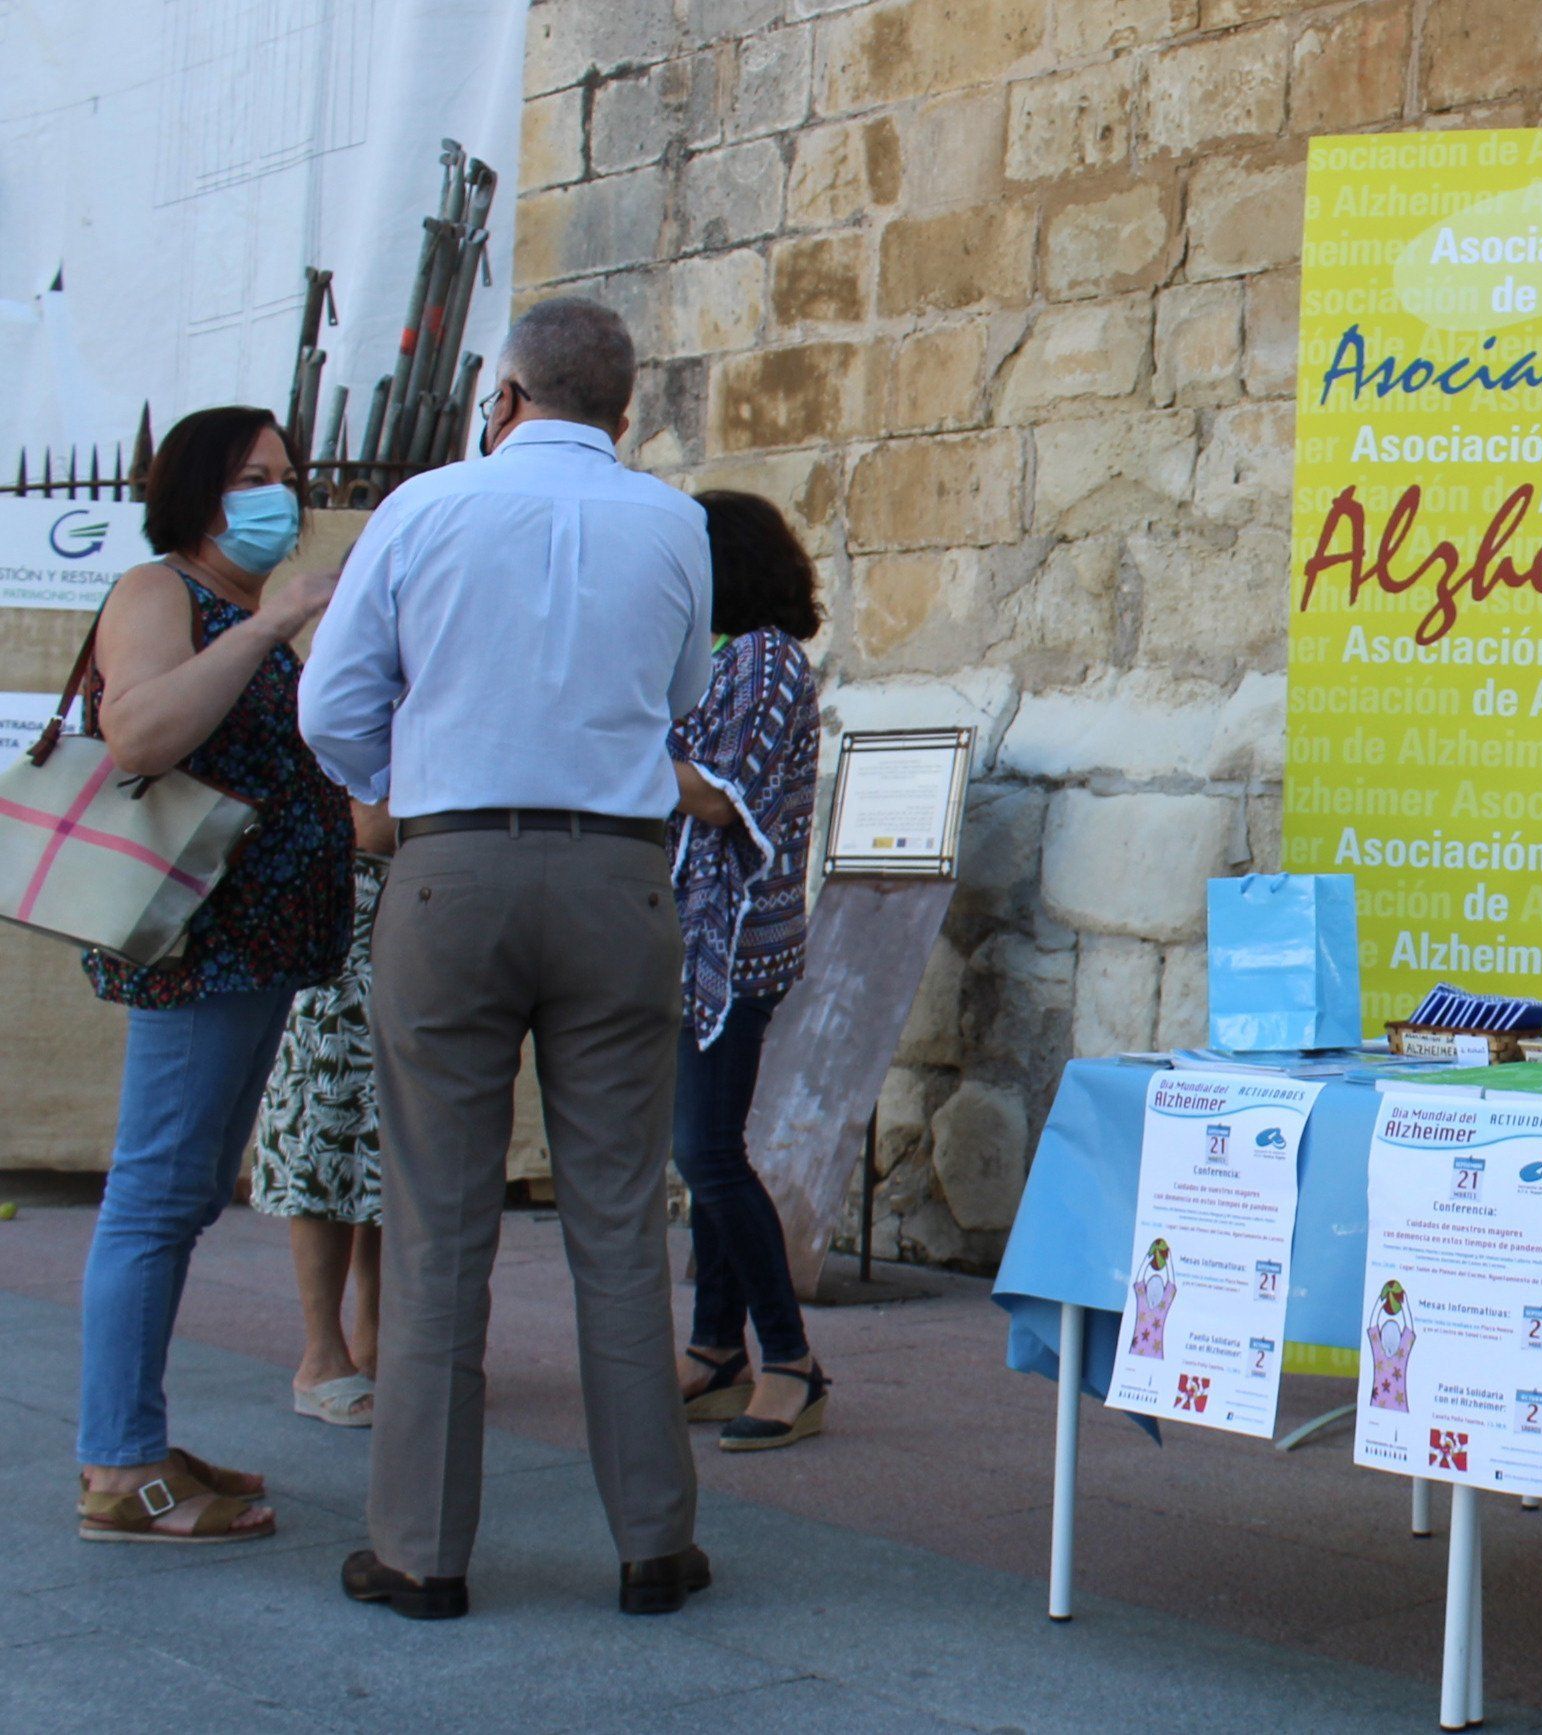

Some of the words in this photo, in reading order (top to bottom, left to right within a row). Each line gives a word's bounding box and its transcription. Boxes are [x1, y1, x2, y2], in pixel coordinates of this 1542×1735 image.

[1478, 131, 1519, 166] de
[1491, 276, 1536, 313] de
[1471, 678, 1519, 717] de
[1341, 726, 1387, 766] de
[1463, 883, 1509, 921] de
[1154, 1090, 1226, 1112] Alzheimer
[1238, 1086, 1305, 1101] ACTIVIDADES
[1411, 1110, 1455, 1123] Mundial
[1458, 1112, 1478, 1124] del
[1384, 1120, 1477, 1143] Alzheimer
[1210, 1136, 1226, 1154] 21
[1457, 1169, 1479, 1190] 21
[1433, 1200, 1498, 1217] Conferencia:
[1259, 1272, 1277, 1291] 21
[1418, 1298, 1446, 1312] Mesas
[1255, 1350, 1266, 1369] 2
[1434, 1394, 1449, 1404] con
[1438, 1382, 1465, 1396] Paella
[1466, 1386, 1504, 1400] Solidaria
[1526, 1403, 1539, 1424] 2
